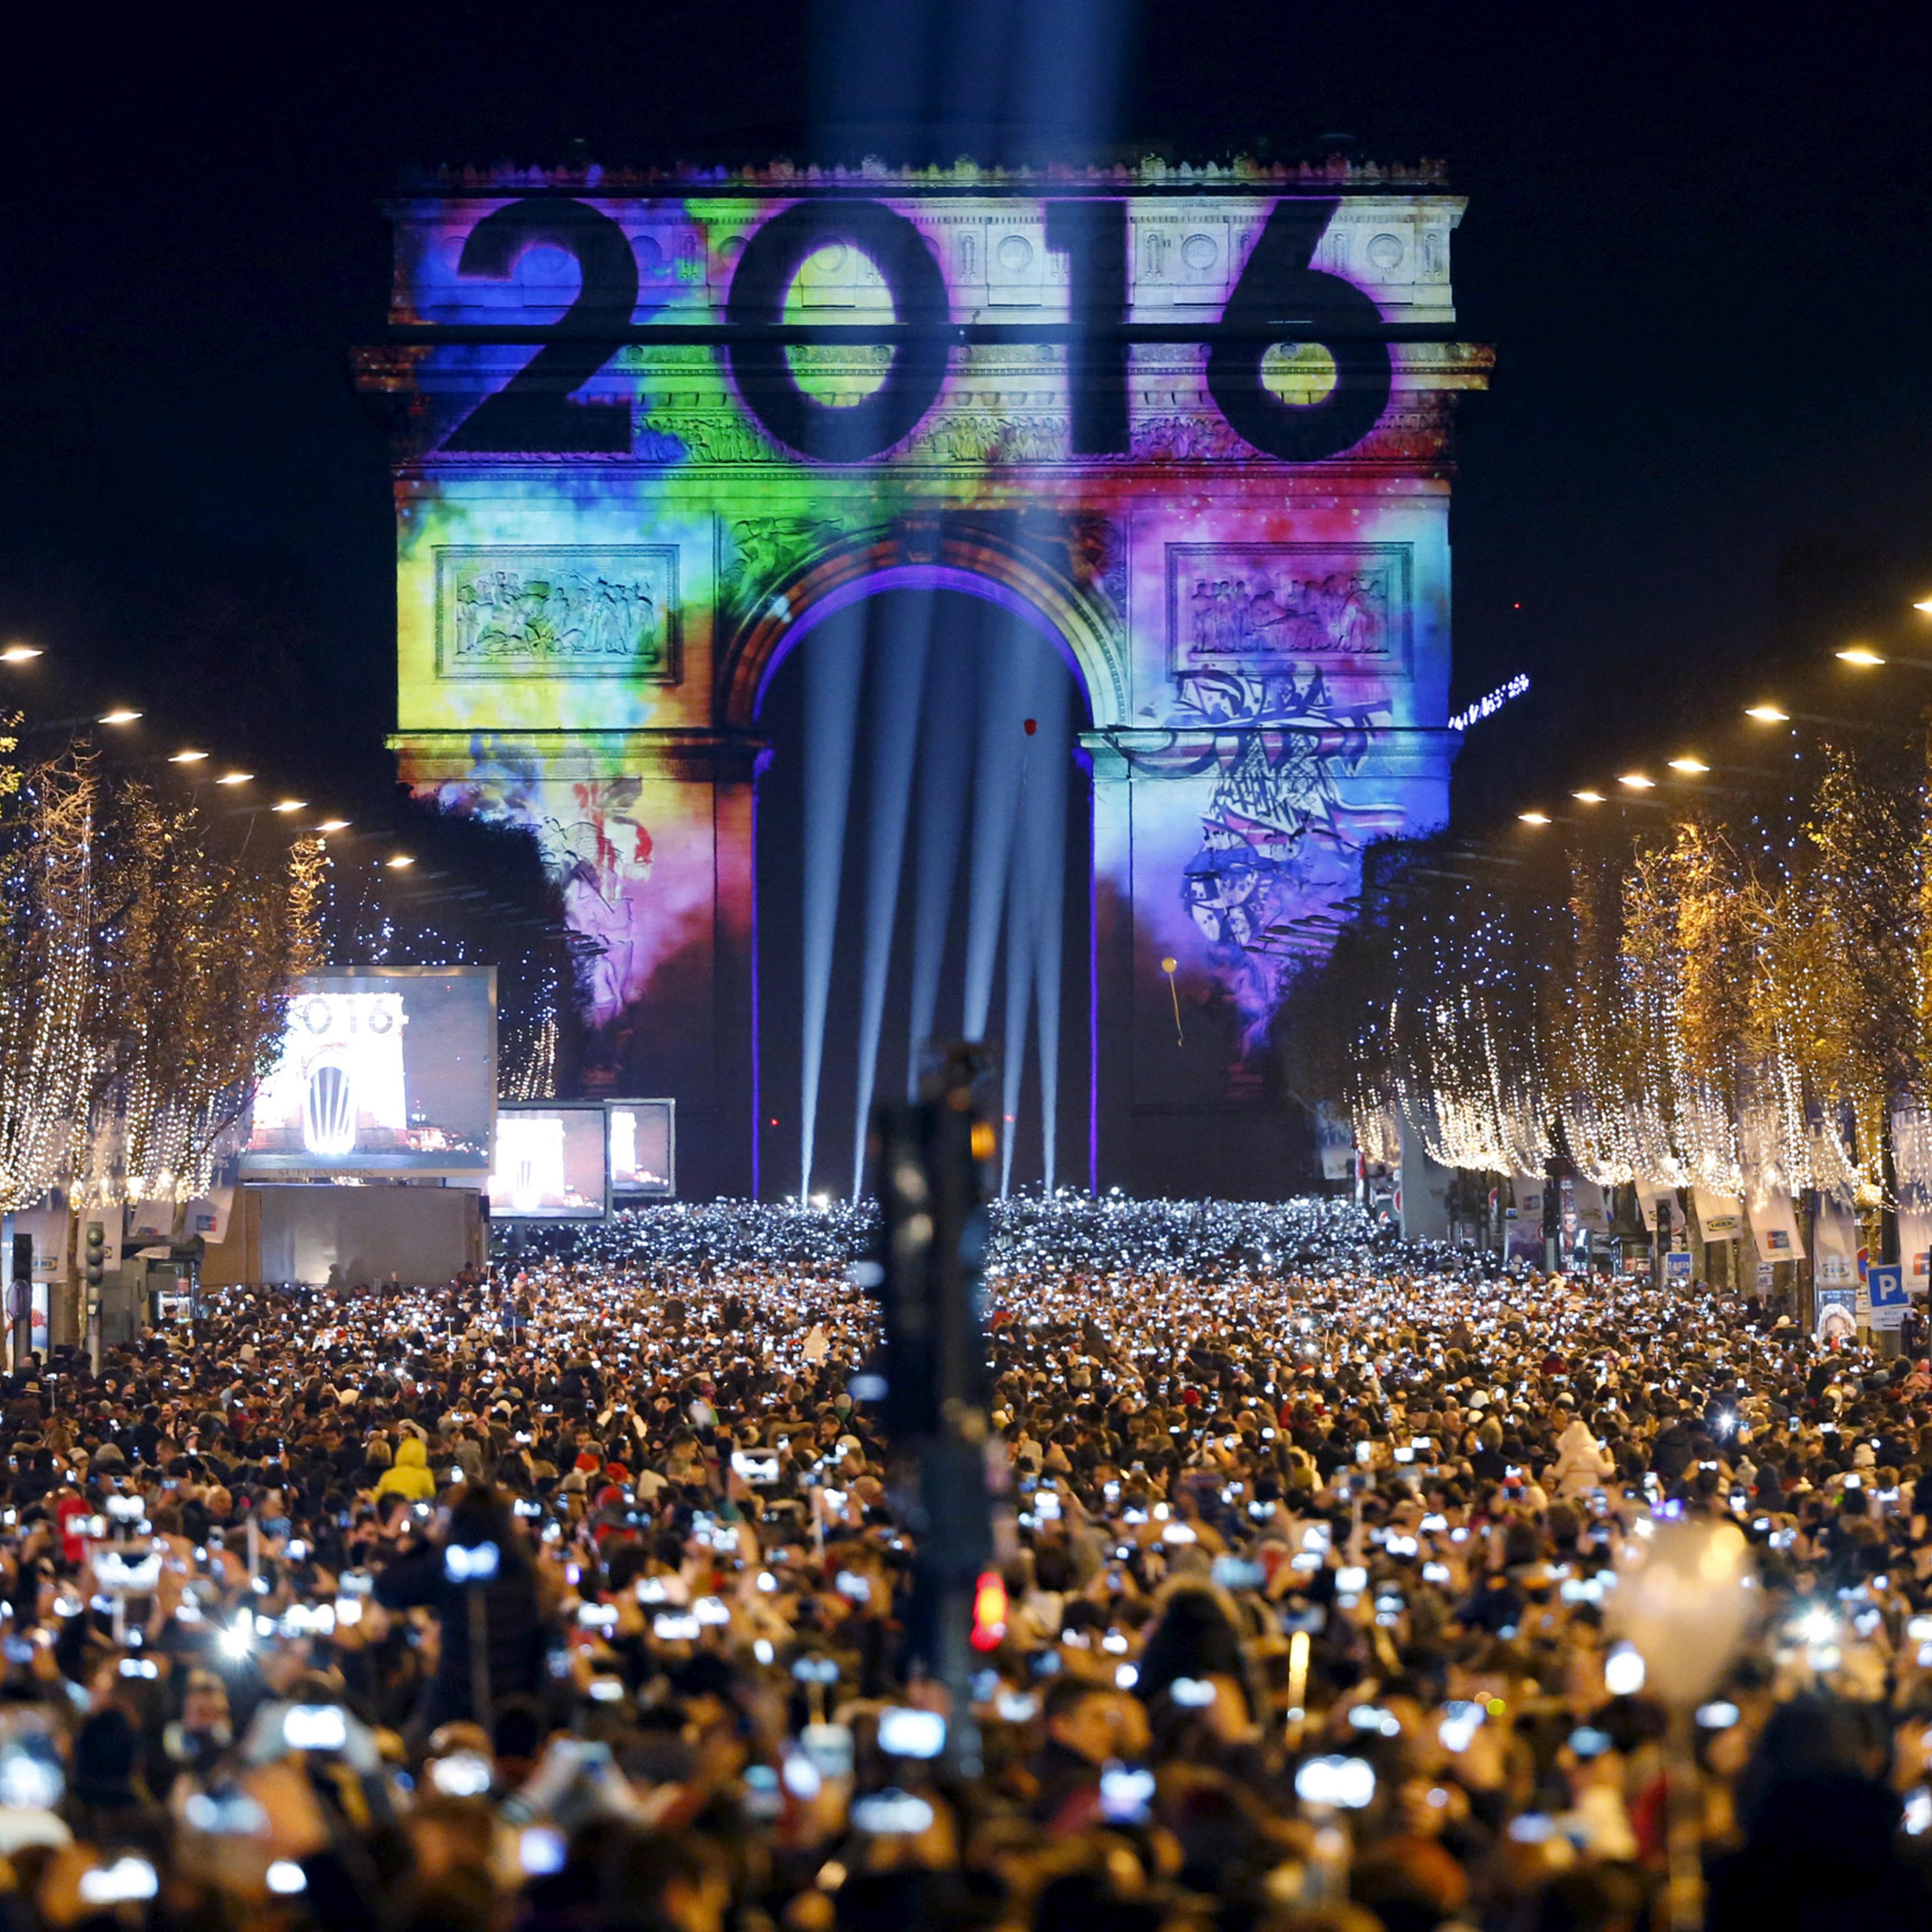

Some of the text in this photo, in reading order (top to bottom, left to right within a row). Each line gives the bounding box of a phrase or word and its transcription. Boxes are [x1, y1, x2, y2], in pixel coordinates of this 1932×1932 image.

[438, 197, 1393, 463] 2016
[303, 998, 393, 1034] 016
[278, 1168, 374, 1176] SUPERVISION
[1879, 1274, 1897, 1300] P
